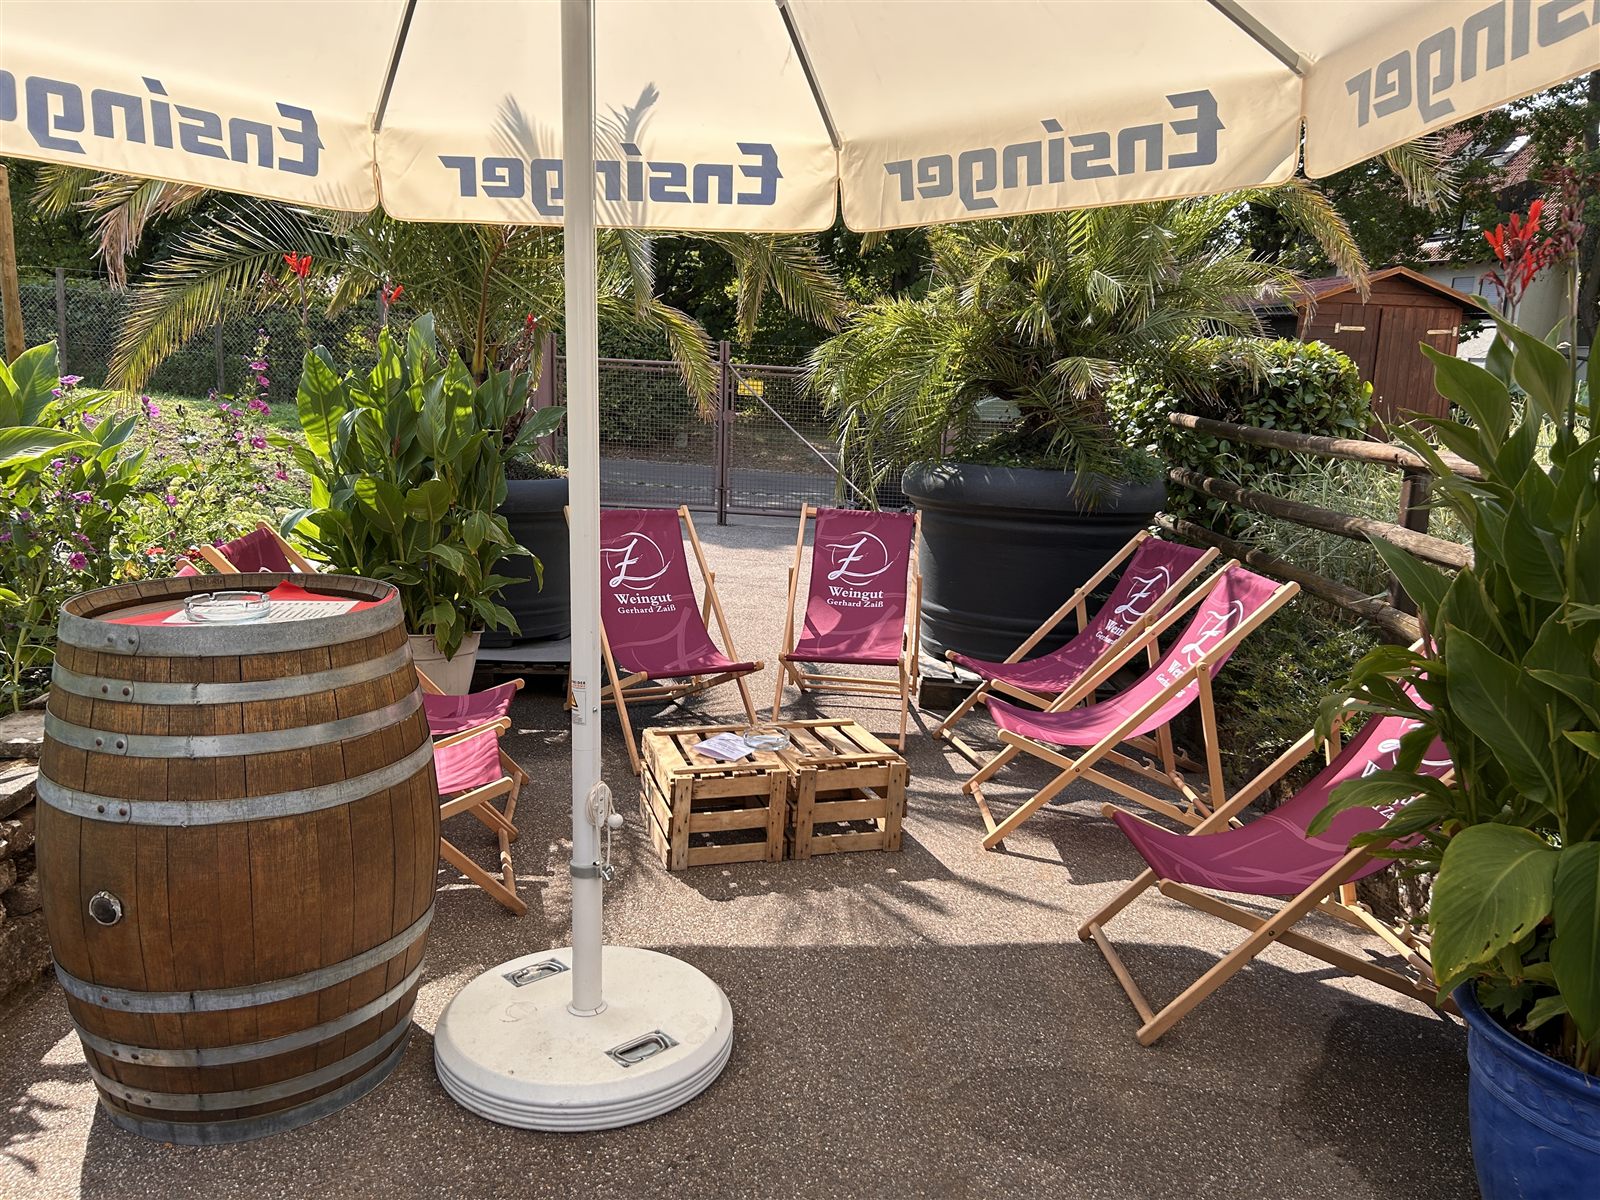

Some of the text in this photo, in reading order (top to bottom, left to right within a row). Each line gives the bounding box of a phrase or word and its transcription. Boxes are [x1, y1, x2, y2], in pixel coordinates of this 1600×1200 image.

[614, 592, 672, 607] Weingut
[828, 585, 884, 601] Weingut
[617, 606, 655, 615] Gerhard
[826, 598, 861, 608] Gerhard
[1104, 618, 1125, 637] Wein
